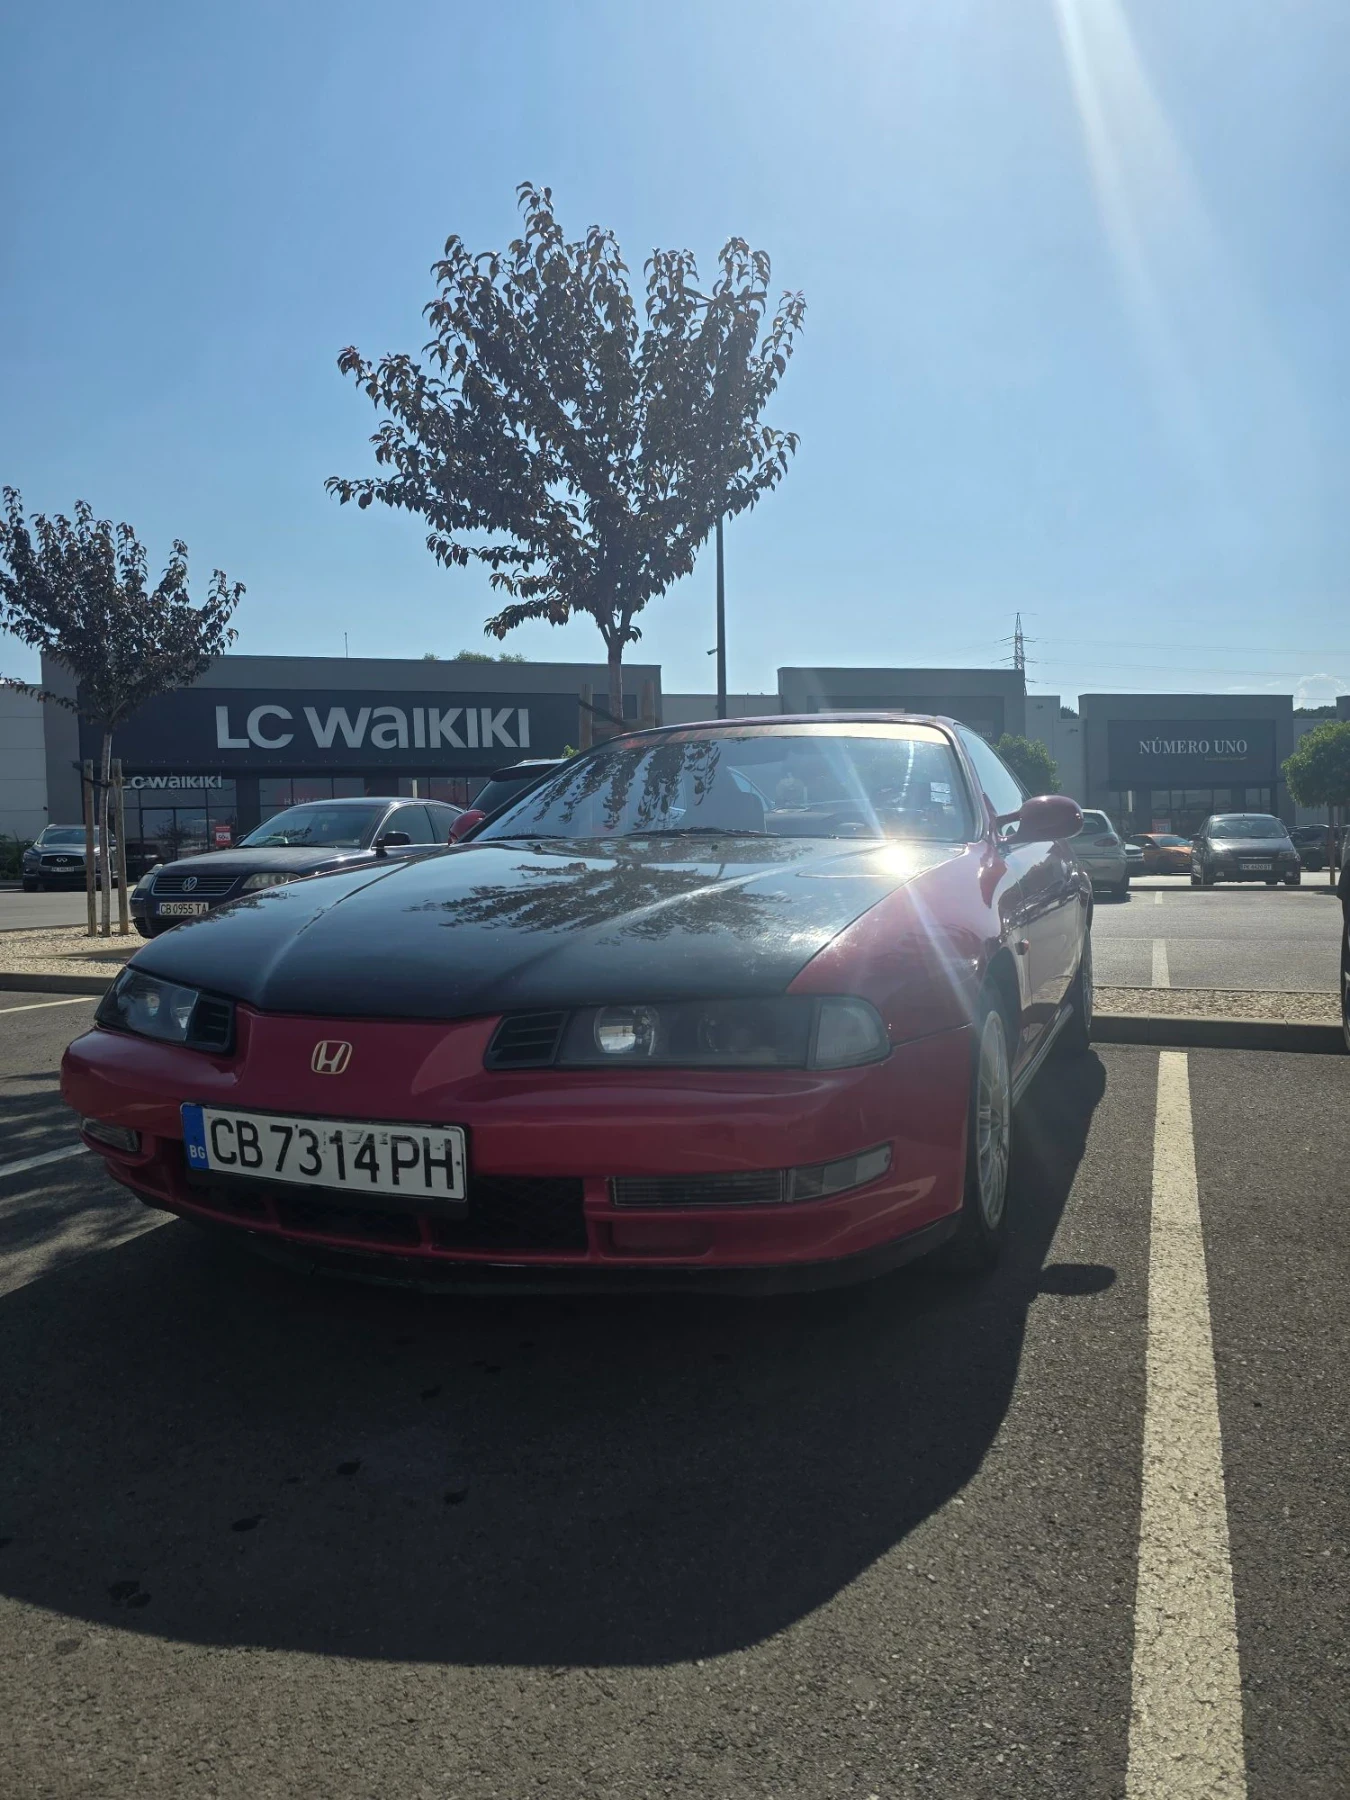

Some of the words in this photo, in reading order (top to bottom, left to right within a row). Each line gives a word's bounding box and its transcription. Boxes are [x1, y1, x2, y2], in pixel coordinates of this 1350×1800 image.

[215, 704, 295, 749] LC
[1139, 736, 1210, 754] NÚMERO
[1214, 739, 1248, 754] UNO
[160, 903, 171, 915] CB
[173, 903, 194, 915] 0955
[189, 1144, 206, 1160] BG
